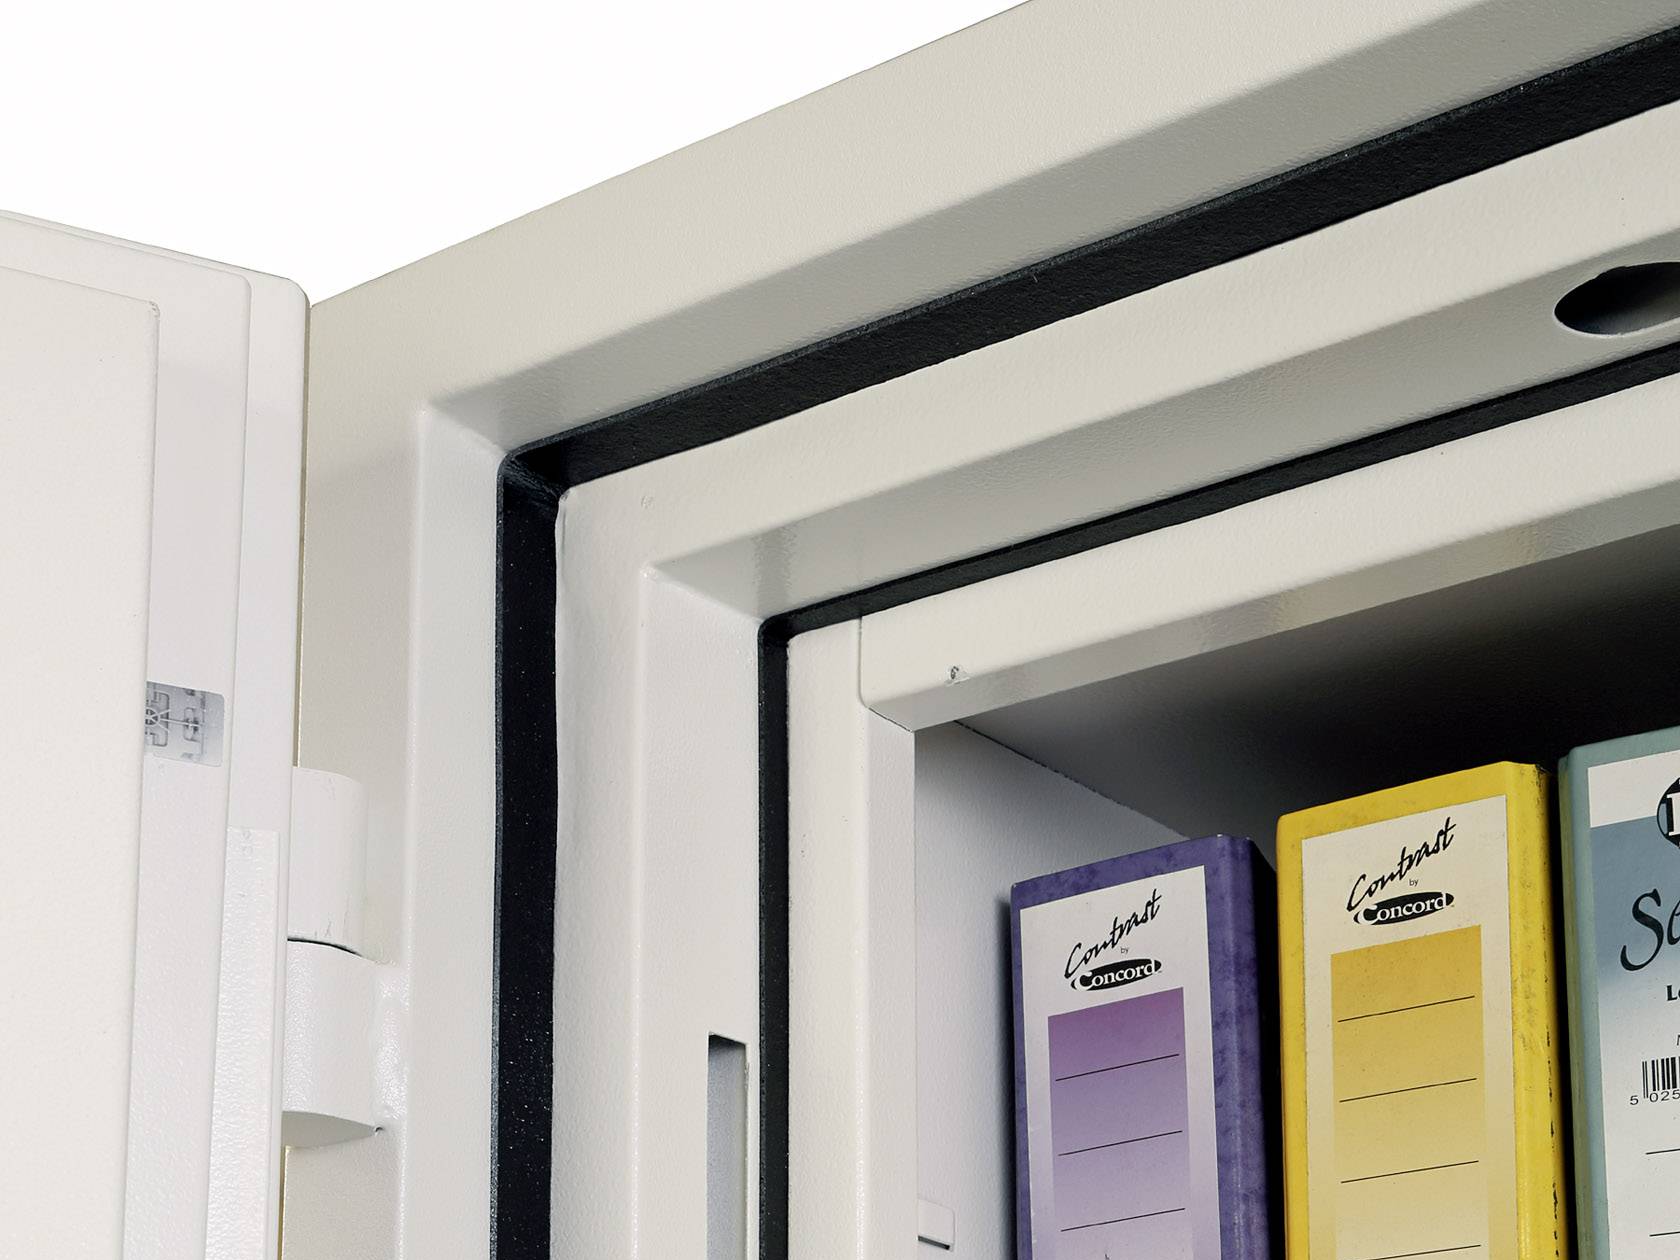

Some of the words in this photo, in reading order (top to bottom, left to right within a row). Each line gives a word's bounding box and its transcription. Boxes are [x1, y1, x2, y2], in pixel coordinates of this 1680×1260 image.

[1346, 817, 1456, 912] Contrast
[1409, 878, 1419, 888] by
[1359, 892, 1448, 925] Concord
[1064, 888, 1162, 979] Contrast
[1120, 946, 1130, 955] by
[1074, 958, 1156, 991] Concord
